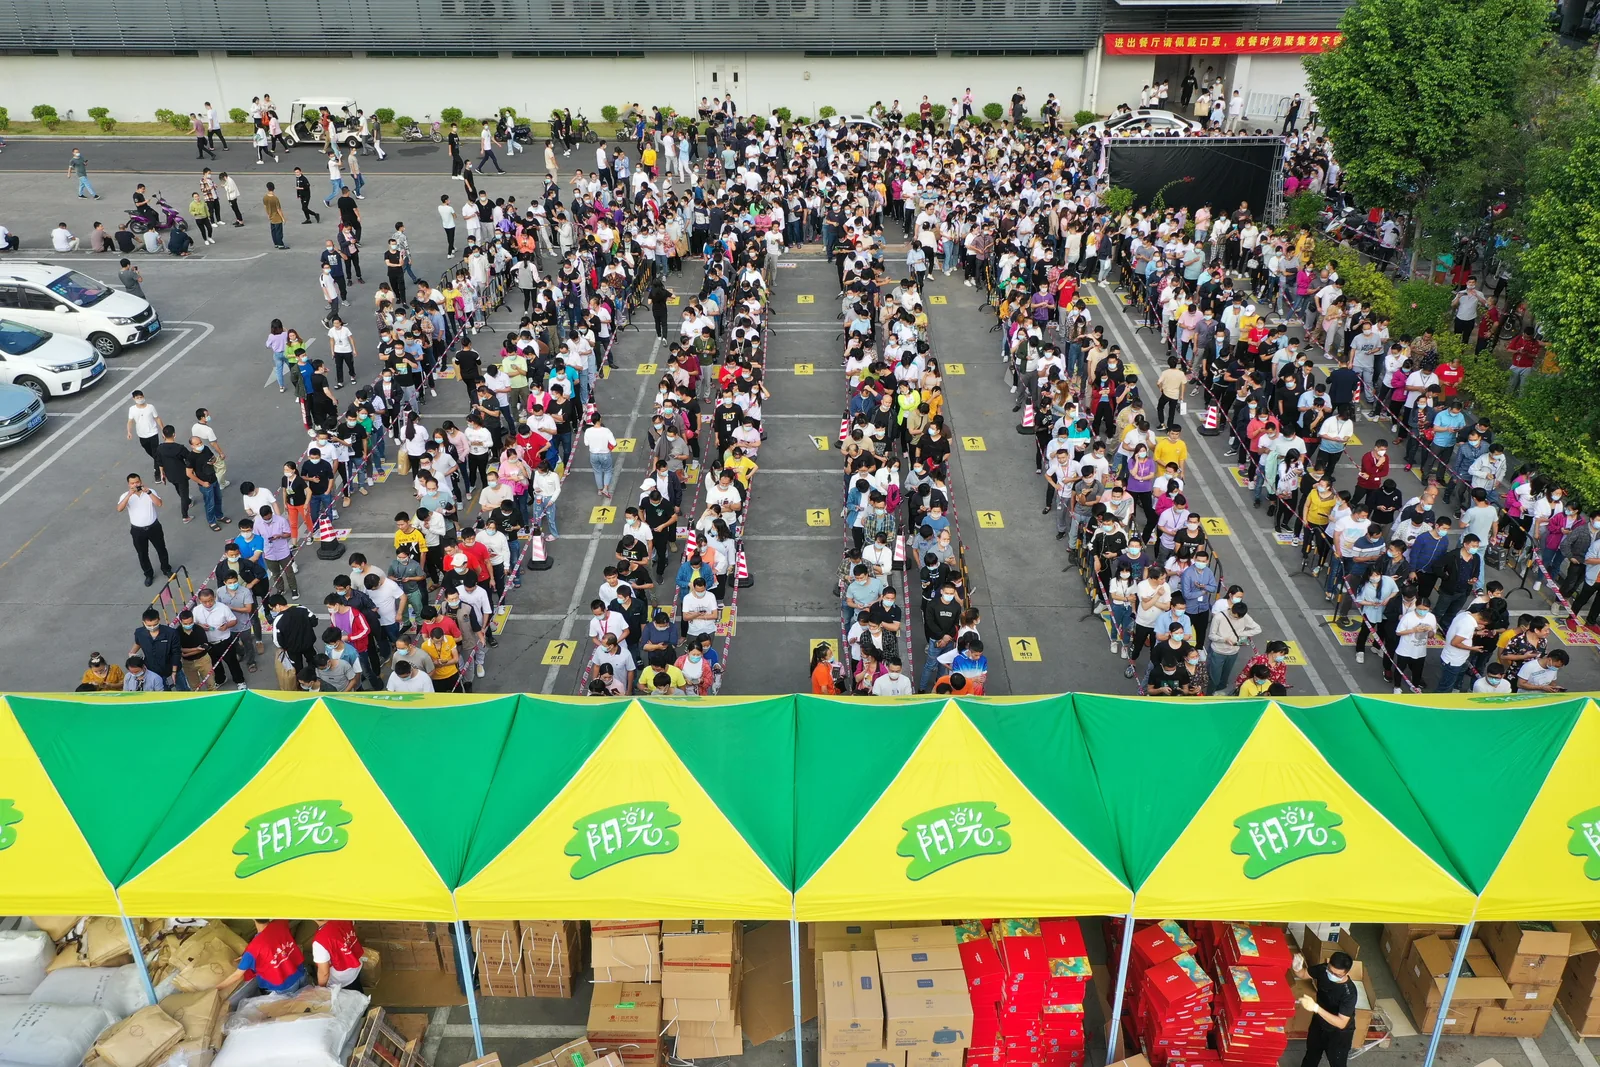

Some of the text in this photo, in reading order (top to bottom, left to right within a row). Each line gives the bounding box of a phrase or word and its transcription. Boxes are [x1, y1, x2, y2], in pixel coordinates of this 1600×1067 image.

[257, 805, 333, 860] 阳光
[586, 807, 663, 862] 阳光
[916, 807, 994, 862] 阳光
[1248, 806, 1328, 860] 阳光
